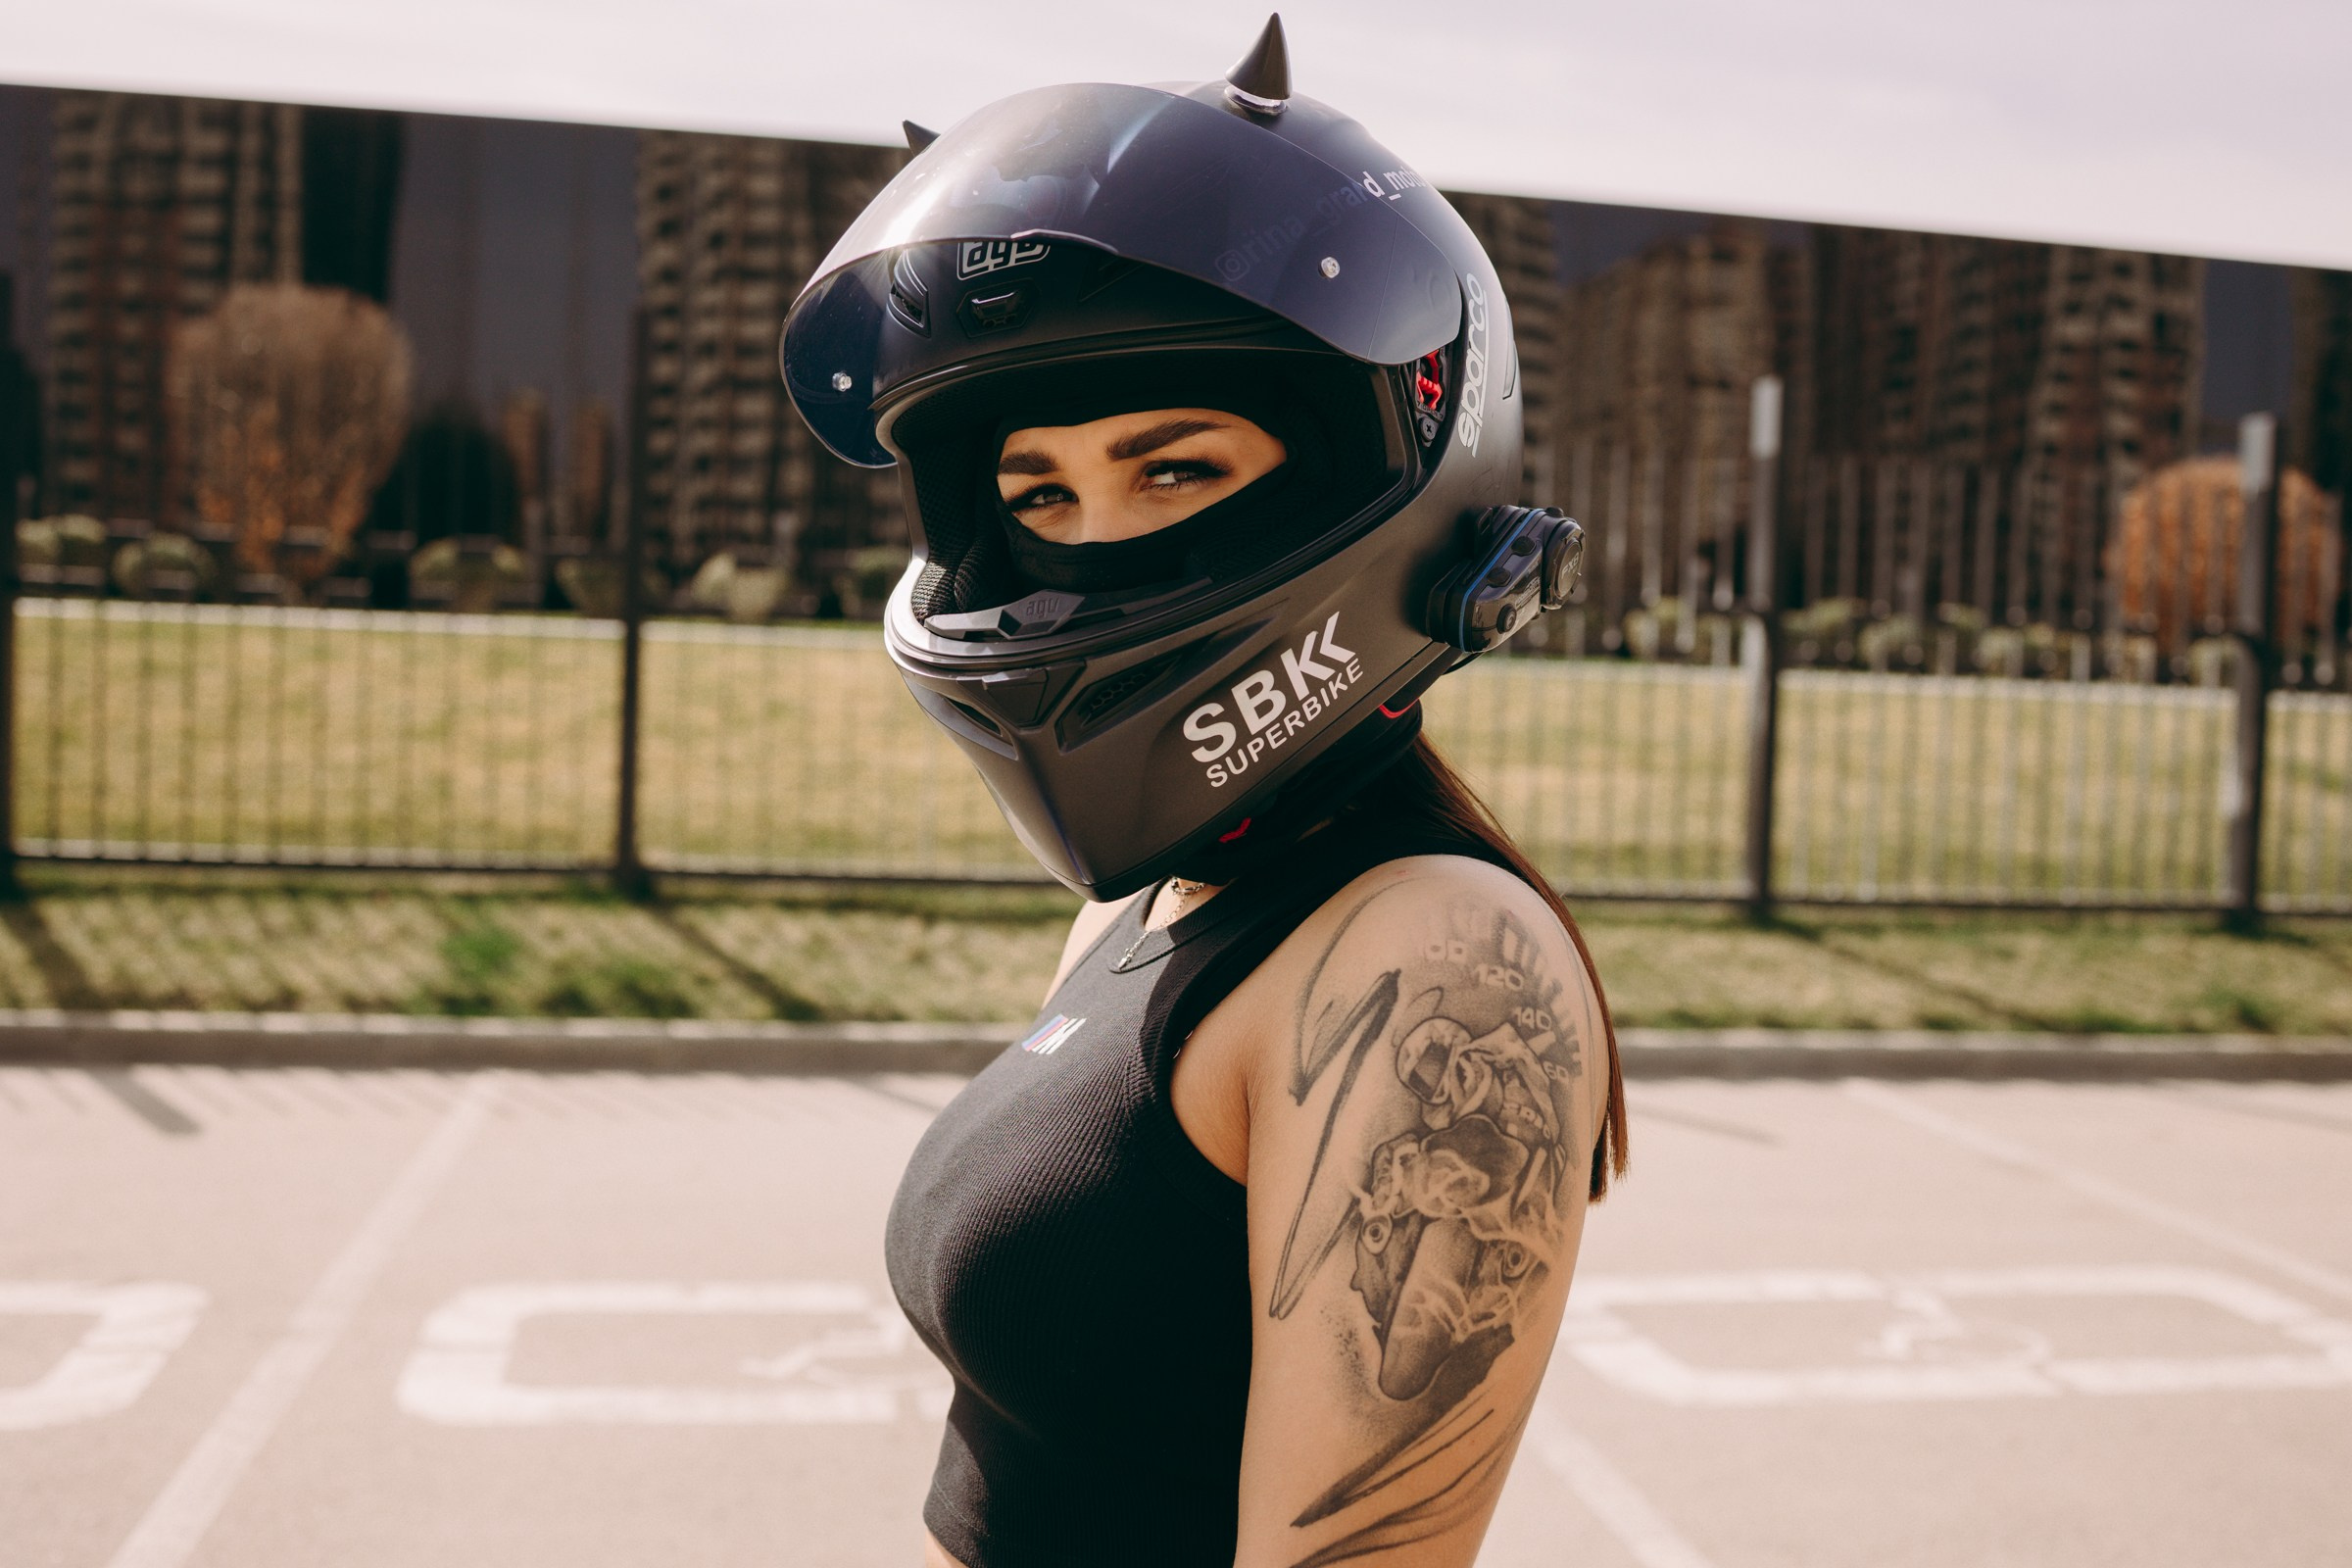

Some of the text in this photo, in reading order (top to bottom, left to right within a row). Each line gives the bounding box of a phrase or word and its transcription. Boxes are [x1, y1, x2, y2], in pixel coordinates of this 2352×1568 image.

[1458, 273, 1486, 449] sparco
[1026, 597, 1059, 619] agv
[1205, 658, 1363, 787] SUPERBIKE
[1474, 963, 1524, 992] 120
[1513, 1006, 1552, 1031] 140
